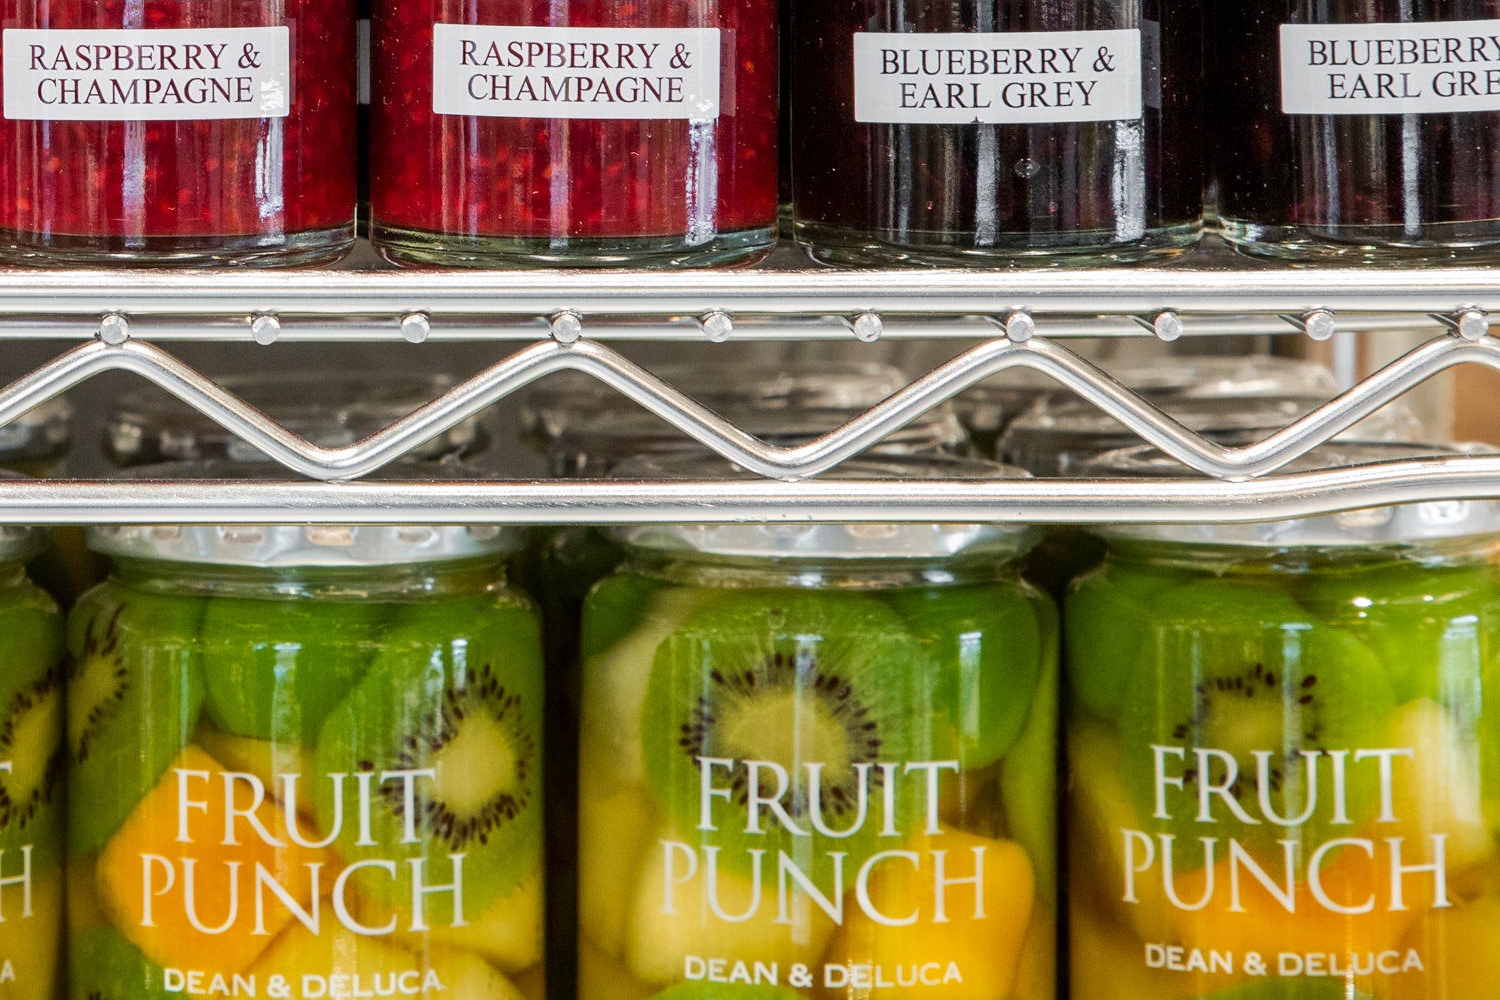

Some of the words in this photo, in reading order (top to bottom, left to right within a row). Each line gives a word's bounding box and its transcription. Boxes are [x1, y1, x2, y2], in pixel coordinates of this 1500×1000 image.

[29, 44, 228, 71] RASPBERRY
[238, 43, 261, 69] &
[460, 40, 660, 69] RASPBERRY
[669, 43, 692, 69] &
[880, 48, 1083, 75] BLUEBERRY
[1093, 46, 1115, 72] &
[38, 77, 253, 104] CHAMPAGNE
[468, 74, 684, 103] CHAMPAGNE
[899, 82, 991, 109] EARL
[1002, 81, 1097, 109] GREY
[1328, 72, 1422, 98] EARL
[1432, 70, 1500, 98] GRE
[696, 756, 959, 838] FRUIT
[1150, 744, 1414, 826] FRUIT
[174, 768, 436, 848] FRUIT
[660, 841, 988, 926] PUNCH
[1121, 828, 1452, 914] PUNCH
[140, 852, 468, 936] PUNCH
[684, 956, 778, 985] DEAN
[789, 963, 812, 987] &
[825, 961, 962, 988] DELUCA
[1146, 944, 1232, 974] DEAN
[1244, 952, 1266, 976] &
[1279, 949, 1424, 976] DELUCA
[164, 968, 256, 997] DEAN
[268, 974, 291, 998] &
[302, 969, 446, 998] DELUCA
